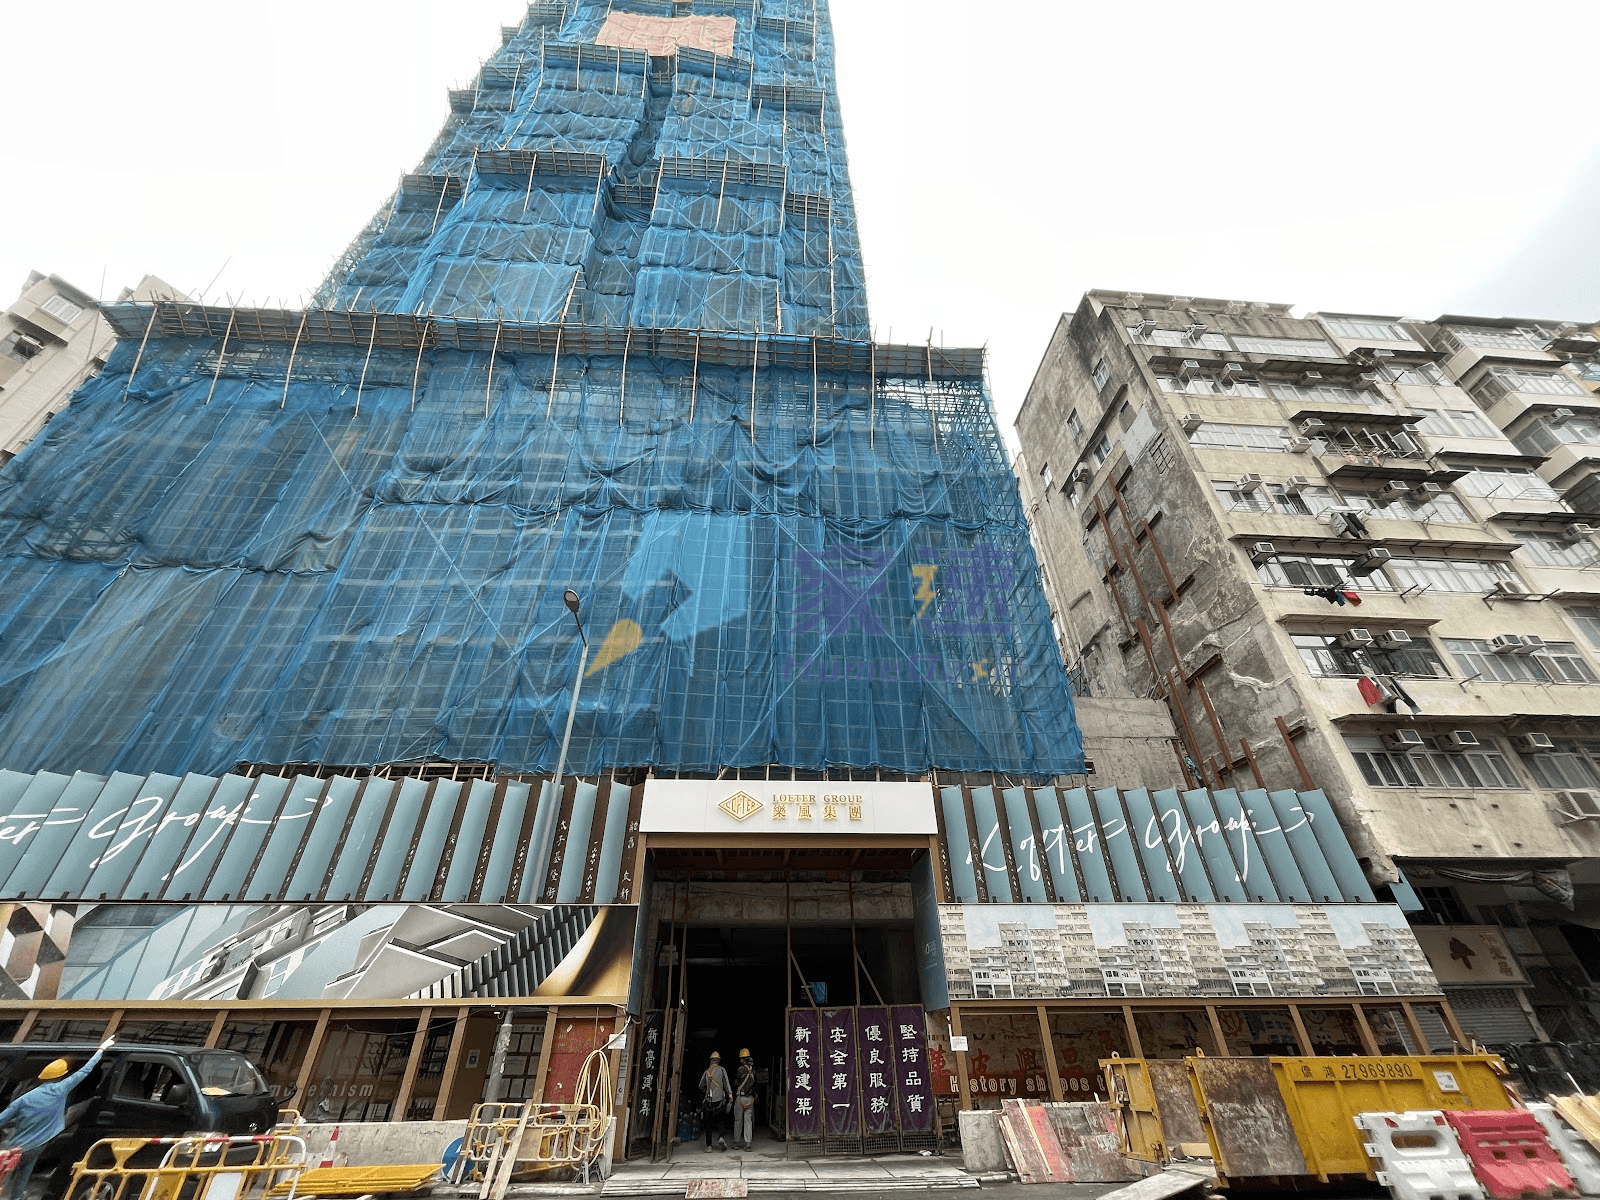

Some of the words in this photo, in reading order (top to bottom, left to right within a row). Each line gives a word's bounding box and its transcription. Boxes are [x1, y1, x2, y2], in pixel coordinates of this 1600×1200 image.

[723, 793, 758, 817] LOFTER
[772, 794, 816, 803] LOFTER
[823, 794, 863, 803] GROUP
[772, 805, 862, 820] 樂風集團
[639, 1027, 658, 1117] 新豪建築
[794, 1026, 813, 1116] 新豪建築
[829, 1027, 850, 1109] 安全第一
[865, 1025, 888, 1114] 優良服務
[900, 1024, 925, 1113] 堅持品質
[949, 1075, 1017, 1095] Hstory
[1026, 1074, 1090, 1095] shpes
[1341, 1063, 1413, 1079] 27969890
